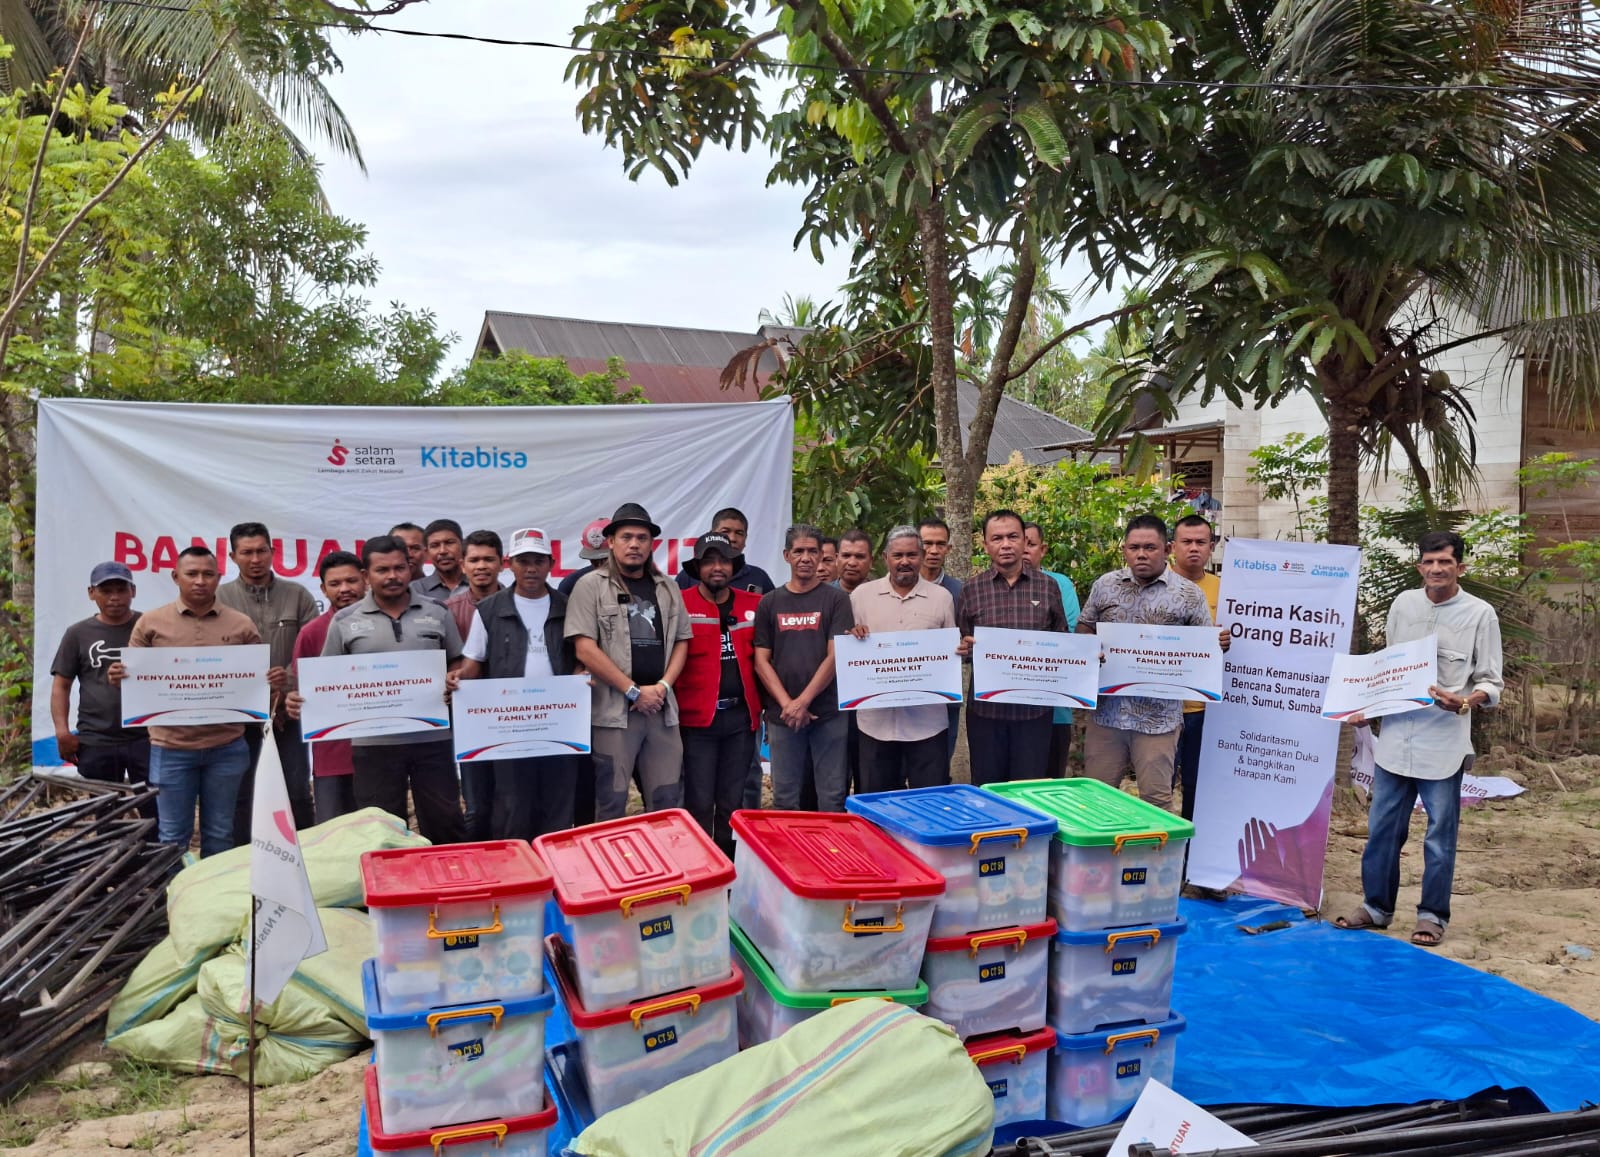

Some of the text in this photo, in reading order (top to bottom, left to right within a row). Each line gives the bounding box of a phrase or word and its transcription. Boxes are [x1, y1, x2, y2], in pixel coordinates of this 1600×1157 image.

[354, 445, 394, 456] salam
[420, 446, 528, 468] Kitabisa
[354, 456, 396, 466] setara
[1233, 558, 1277, 571] Kitabisa
[1225, 598, 1345, 628] Terima Kasih,
[1230, 622, 1335, 648] Orang Baik!
[1110, 648, 1166, 657] PENYALURAN
[848, 654, 948, 667] PENYALURAN BANTUAN
[985, 654, 1087, 666] PENYALURAN BANTUAN
[1012, 664, 1044, 672] FAMILY
[1224, 661, 1263, 676] Bantuan
[1392, 661, 1428, 673] BANTUAN
[315, 678, 432, 693] PENYALURAN BANTUAN
[1231, 678, 1320, 699] Bencana Sumatera
[347, 689, 402, 699] FAMILY KIT
[467, 702, 577, 714] PENYALURAN BANTUAN
[1252, 696, 1285, 711] Sumut,
[1288, 700, 1322, 714] Sumba
[498, 714, 532, 722] FAMILY
[1239, 730, 1300, 748] Solidaritasmu
[1217, 739, 1319, 763] Bantu Ringankan Duka
[1238, 755, 1295, 772] & bangkitkan
[1233, 767, 1297, 785] Harapan Kami
[1461, 783, 1488, 797] atera
[253, 838, 296, 863] mbaga
[990, 862, 997, 871] CT
[654, 920, 671, 933] CT 50
[990, 968, 997, 976] CT
[657, 1031, 675, 1044] CT 50
[463, 1044, 482, 1055] CT 50
[1169, 1119, 1191, 1156] NTUAN
